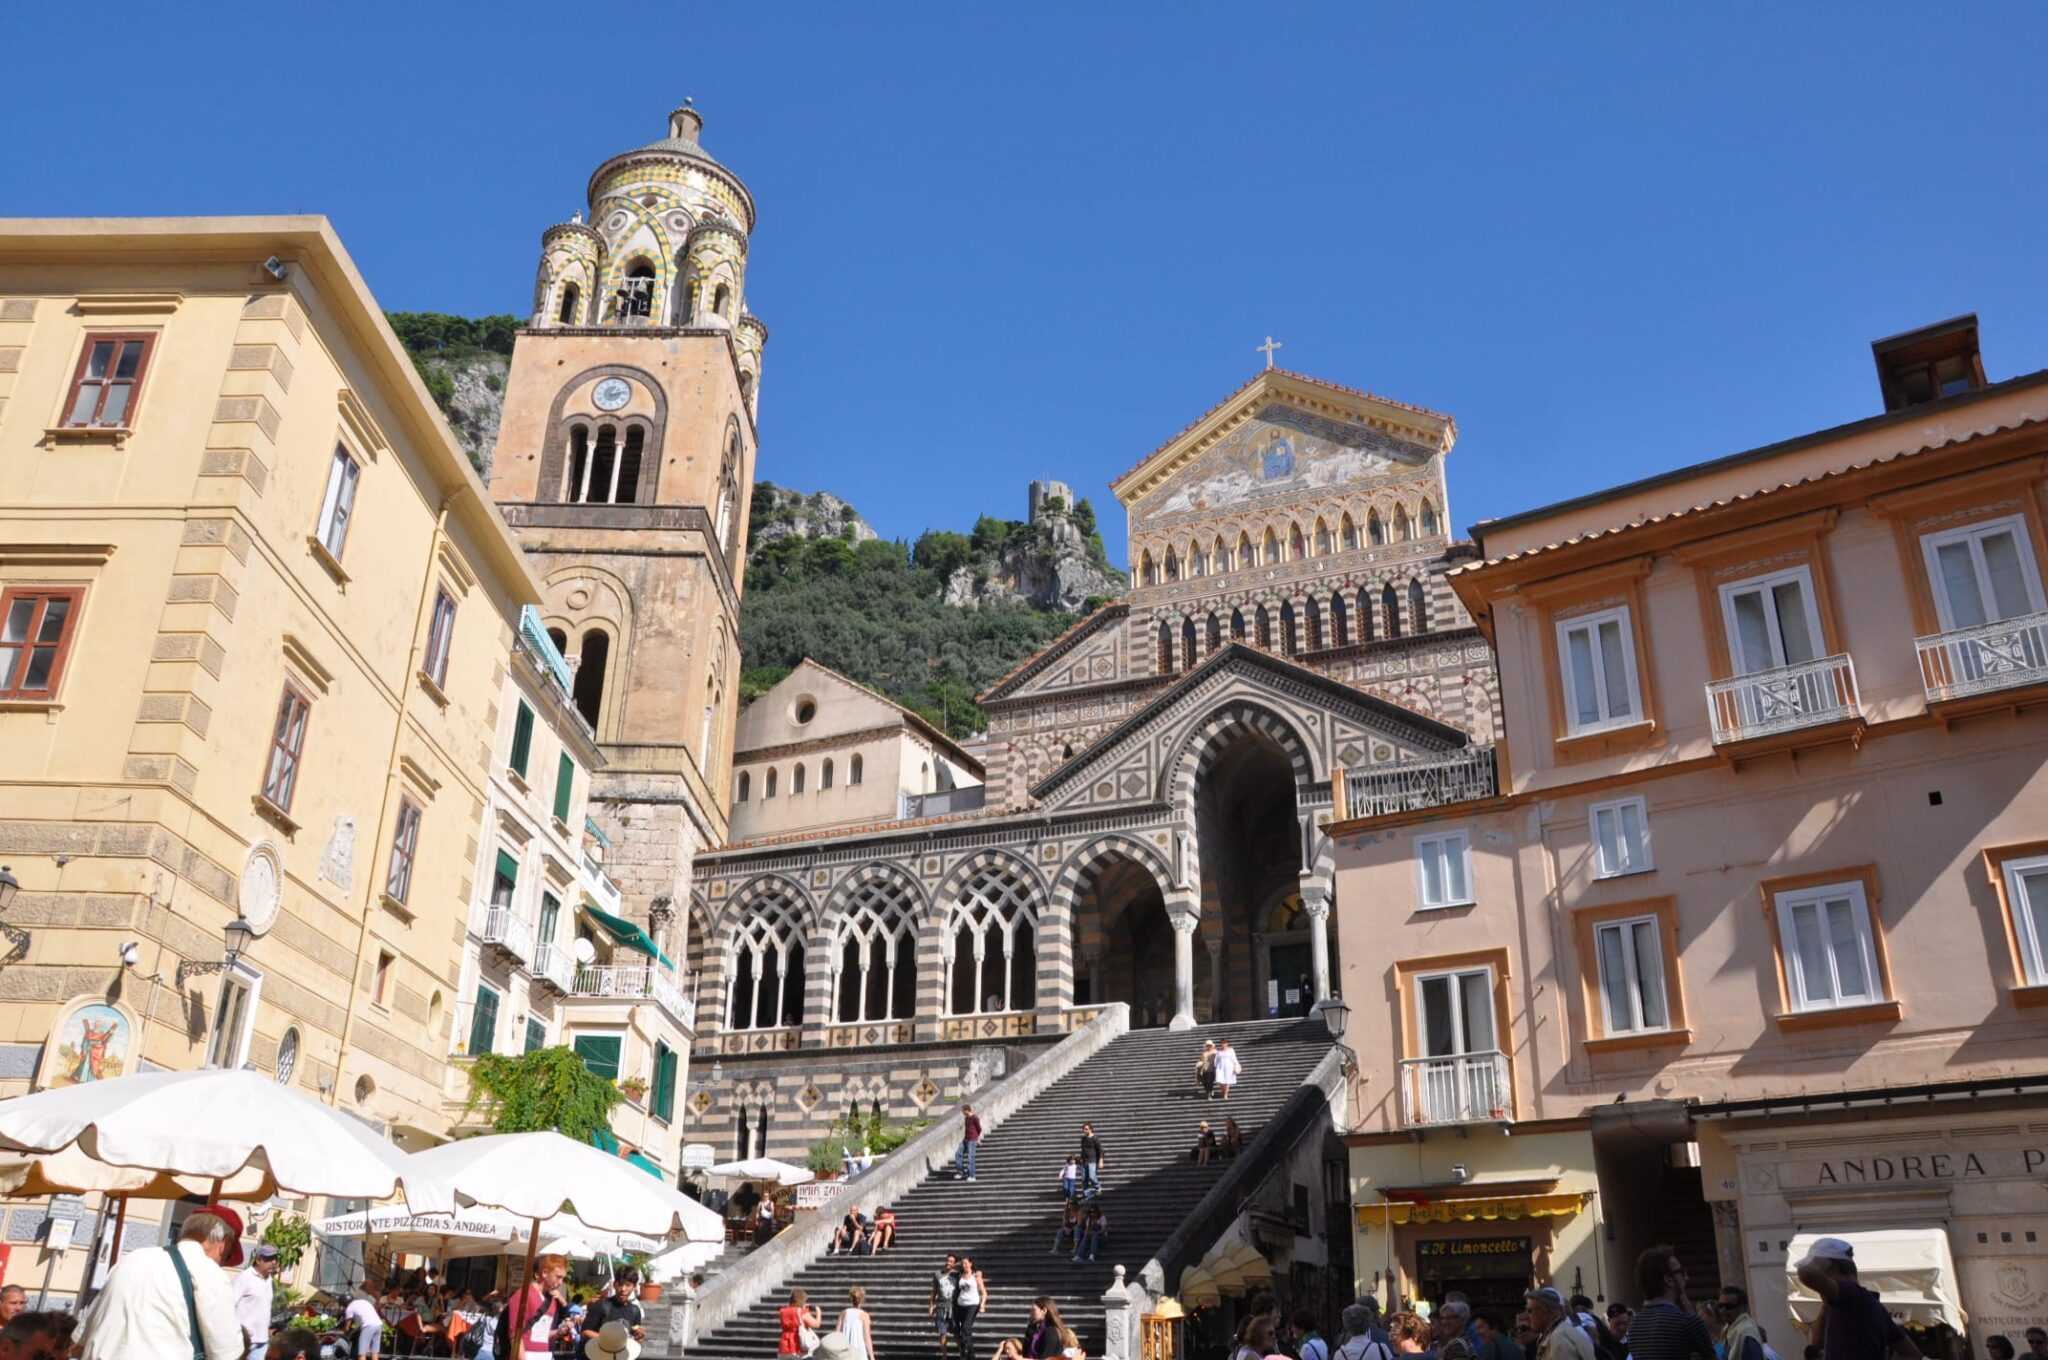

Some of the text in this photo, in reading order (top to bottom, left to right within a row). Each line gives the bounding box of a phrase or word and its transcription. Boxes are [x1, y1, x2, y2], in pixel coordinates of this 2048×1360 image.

[1818, 1152, 1986, 1184] ANDREA
[393, 1216, 440, 1228] PIZZERIA
[454, 1219, 496, 1234] ANDREA
